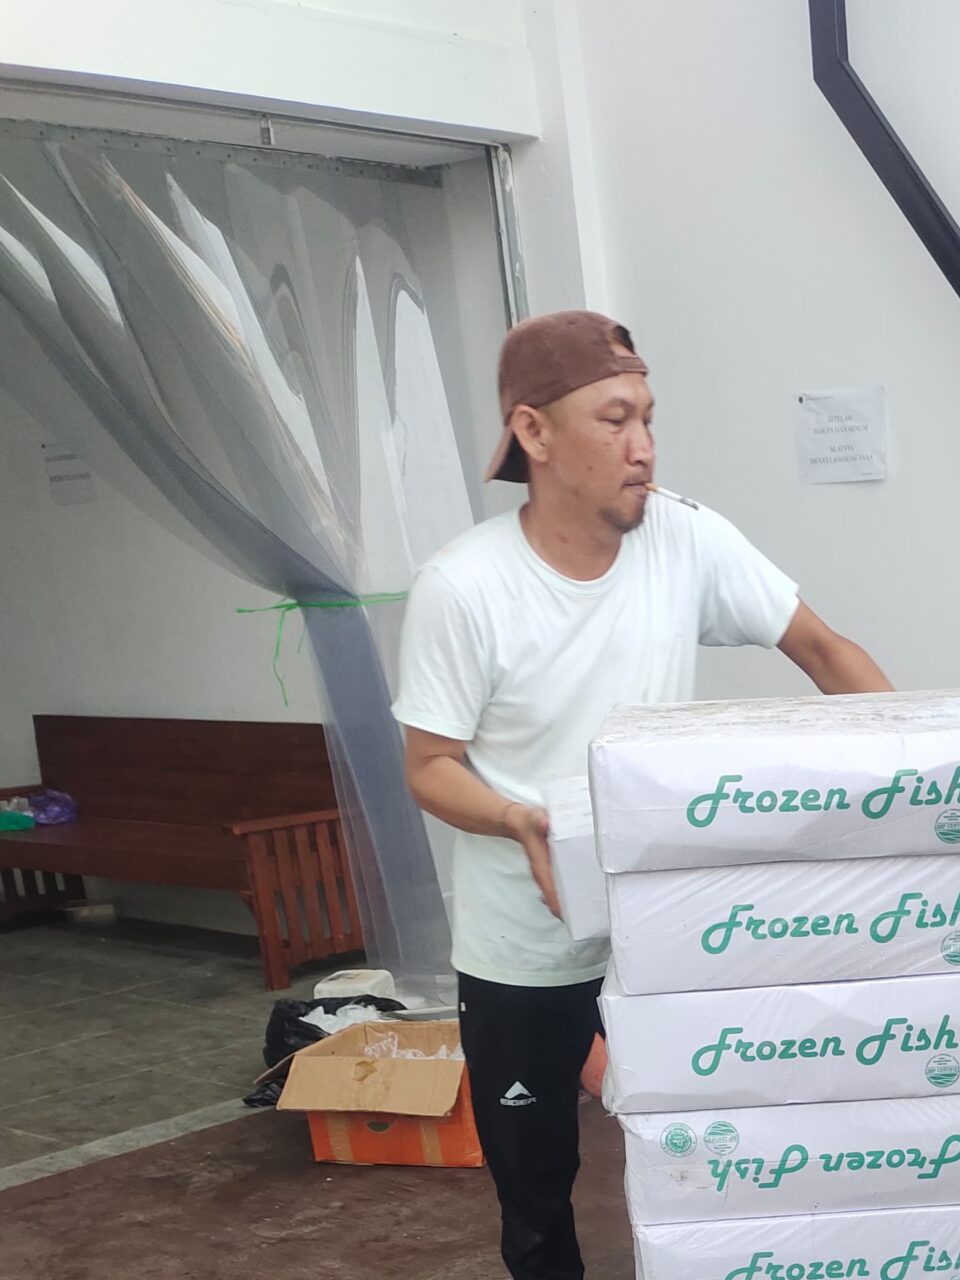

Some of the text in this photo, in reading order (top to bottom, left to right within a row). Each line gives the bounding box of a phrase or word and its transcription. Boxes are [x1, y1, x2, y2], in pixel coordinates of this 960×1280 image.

[687, 775, 850, 828] Frozen
[701, 904, 859, 954] Frozen
[691, 1015, 958, 1076] Frozen Fish
[708, 1144, 809, 1192] Fish
